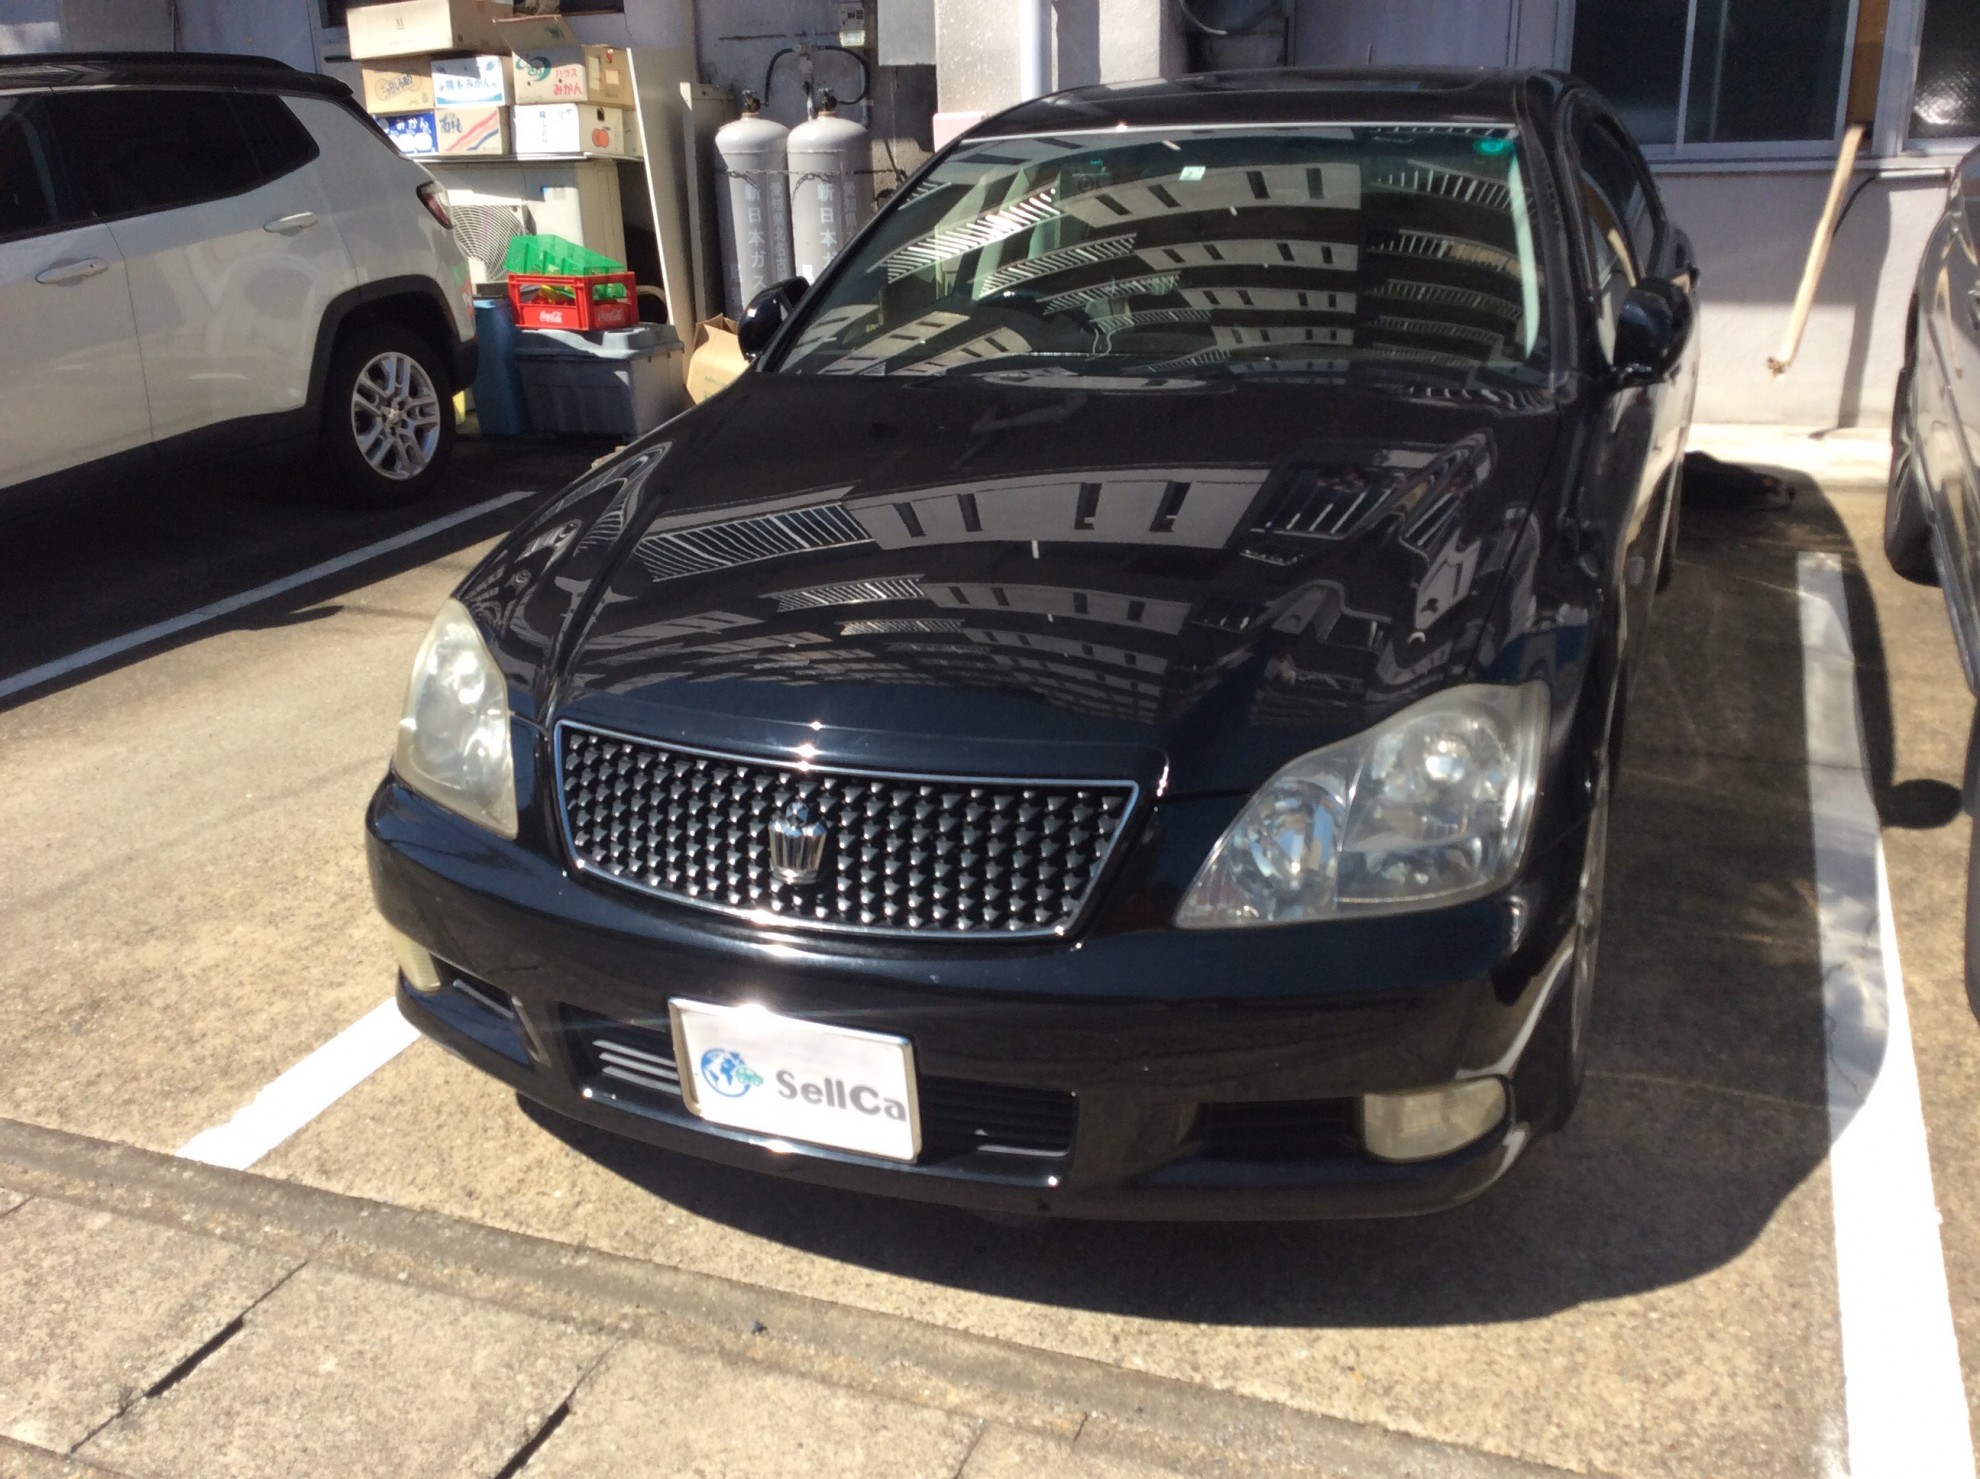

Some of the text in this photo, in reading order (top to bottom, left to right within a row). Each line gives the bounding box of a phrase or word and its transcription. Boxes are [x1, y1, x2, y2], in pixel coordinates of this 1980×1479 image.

[553, 82, 583, 96] みかん
[555, 68, 577, 78] ハウス
[745, 184, 767, 289] 新日本ガス
[775, 1069, 907, 1122] SellCa
